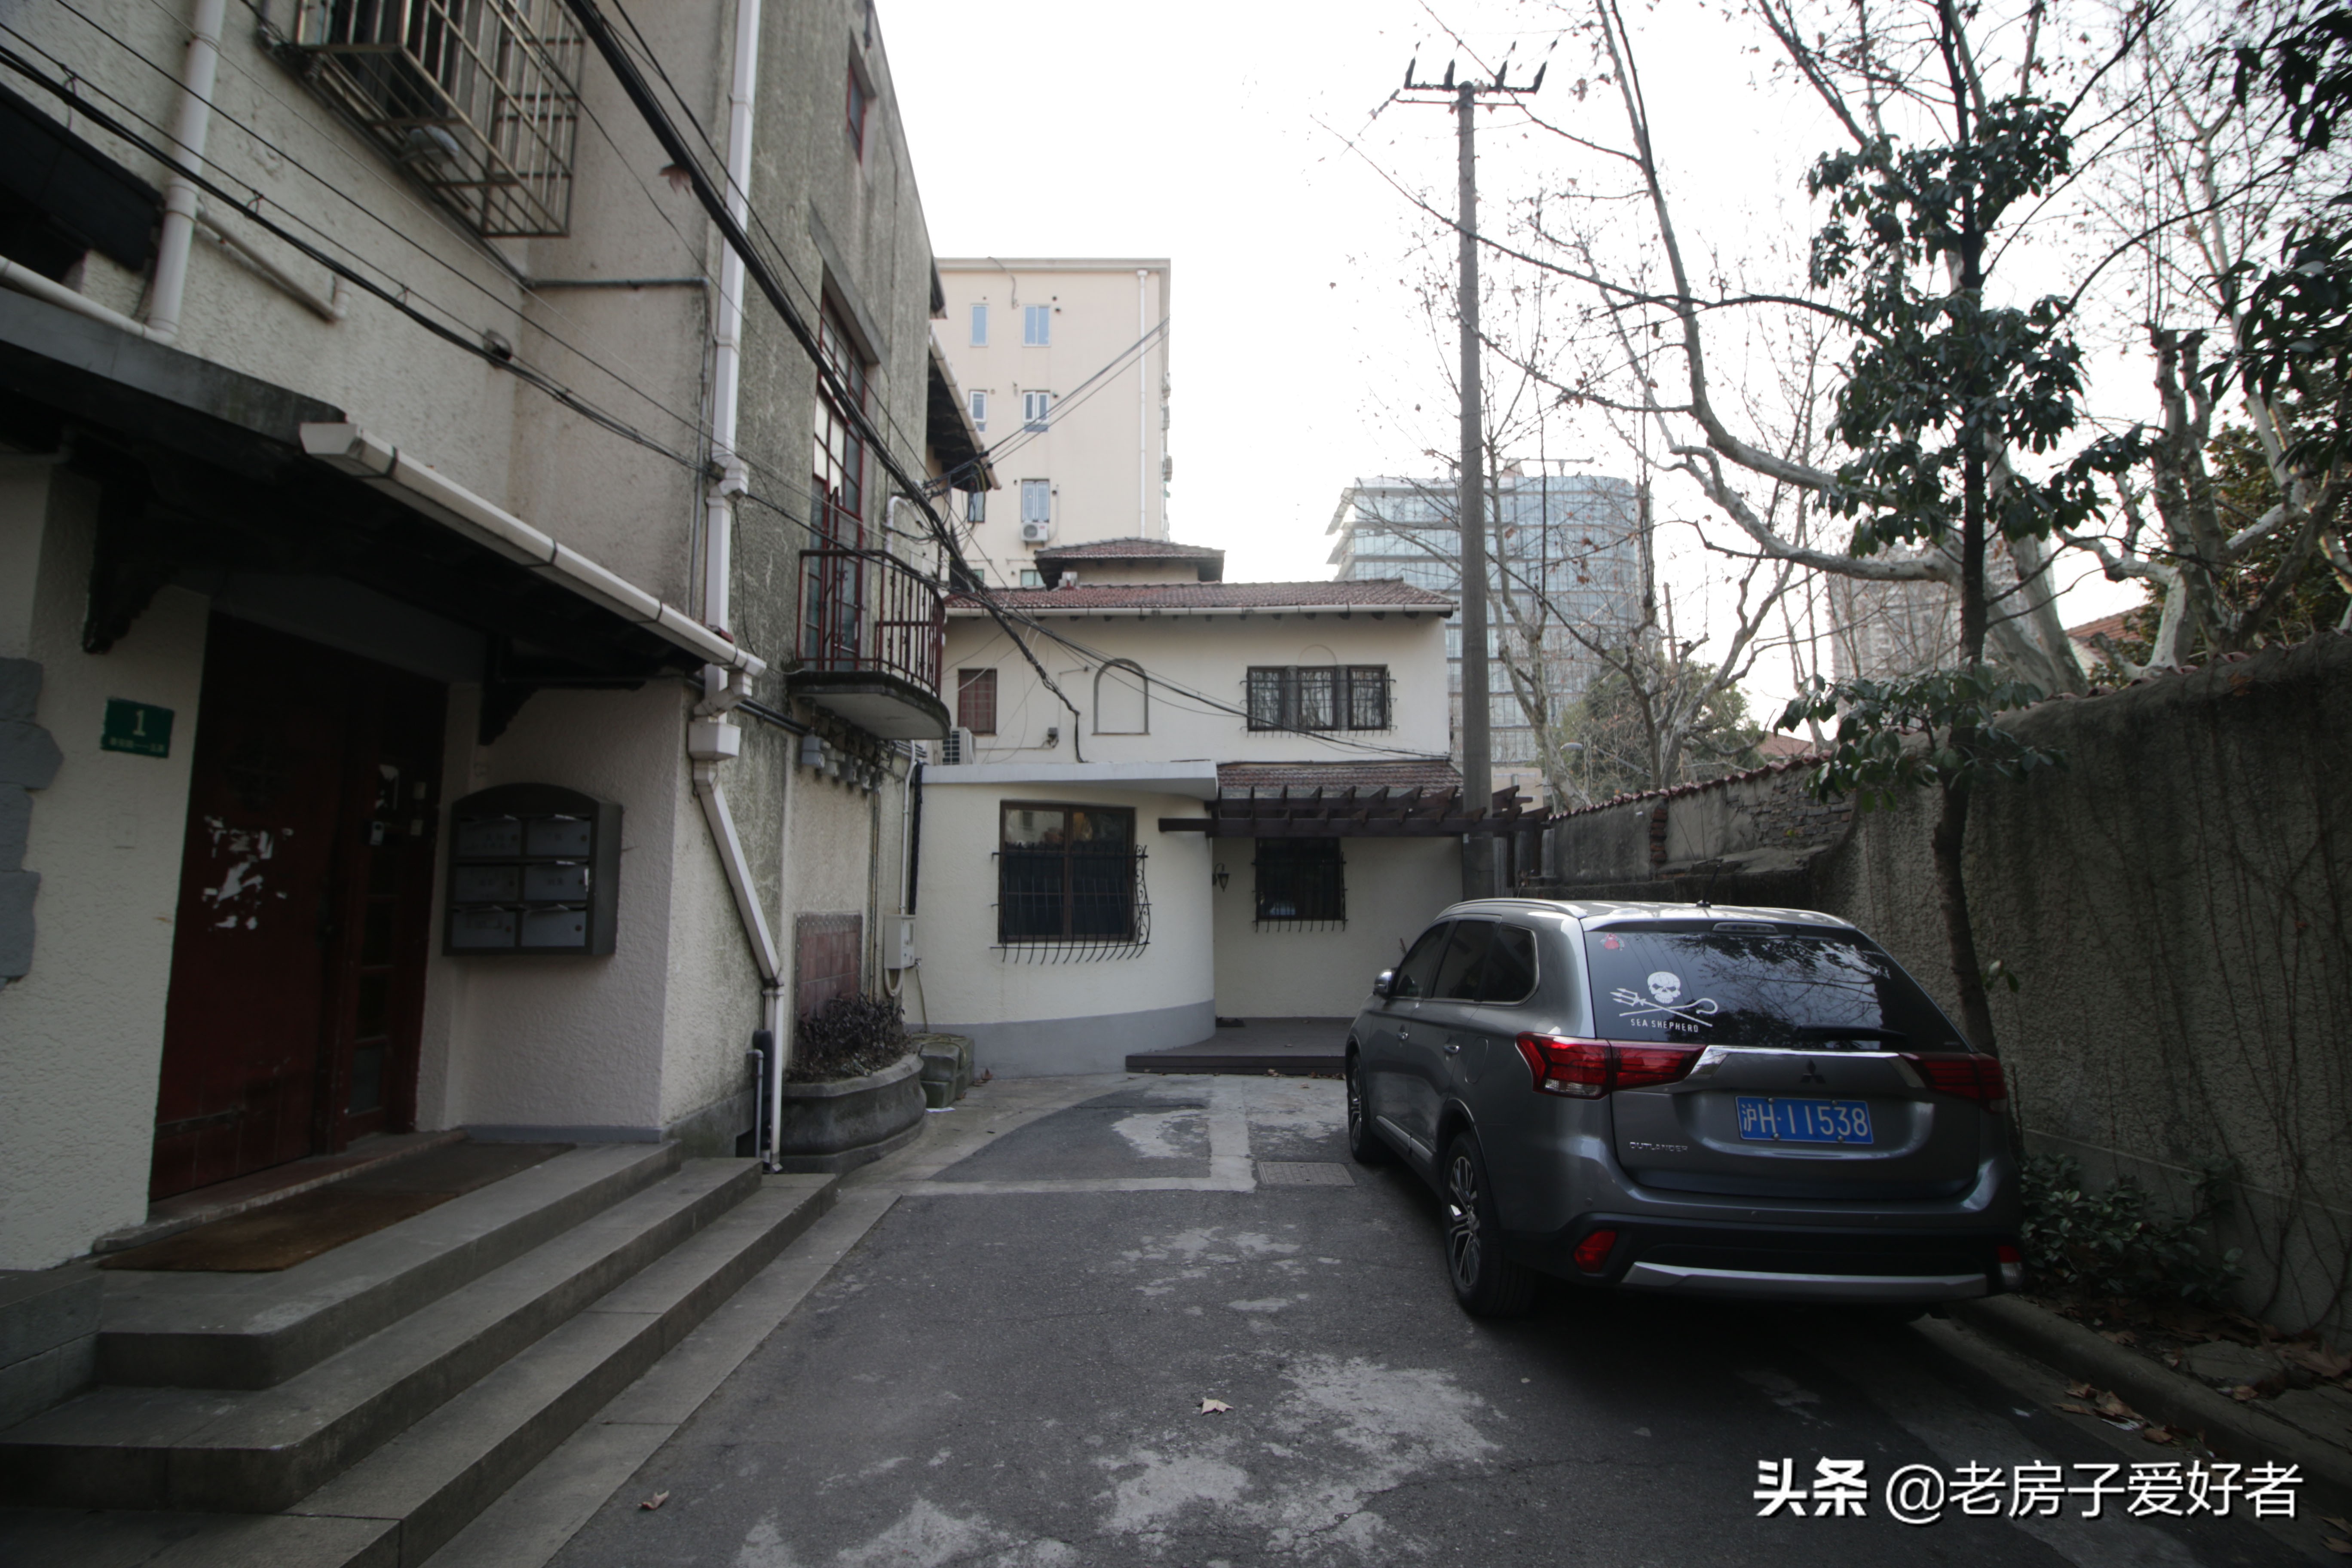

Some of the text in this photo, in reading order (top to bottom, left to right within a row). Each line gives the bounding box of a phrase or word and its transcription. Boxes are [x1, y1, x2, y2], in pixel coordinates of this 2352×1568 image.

[132, 710, 147, 737] 1
[1630, 1018, 1699, 1033] SEA SHEPHERD
[1630, 1142, 1688, 1152] OUTLANDER
